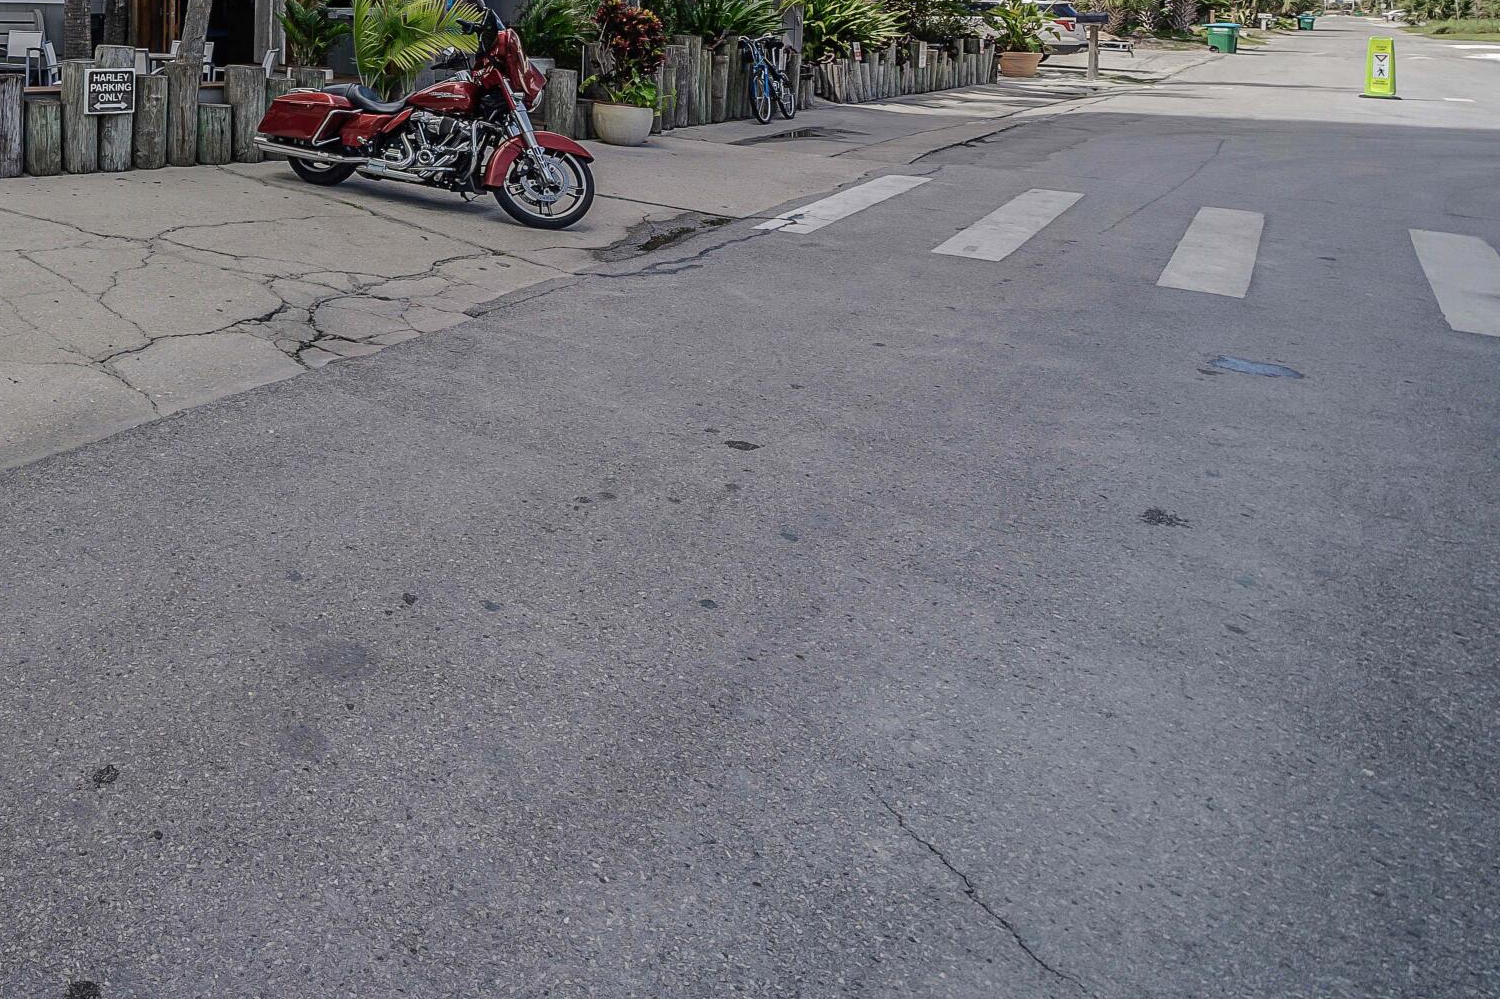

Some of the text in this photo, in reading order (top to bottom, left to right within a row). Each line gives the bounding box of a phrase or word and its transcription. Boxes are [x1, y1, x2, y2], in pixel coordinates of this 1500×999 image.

[93, 73, 129, 82] HARLEY
[90, 83, 132, 92] PARKING
[98, 93, 123, 102] ONLY
